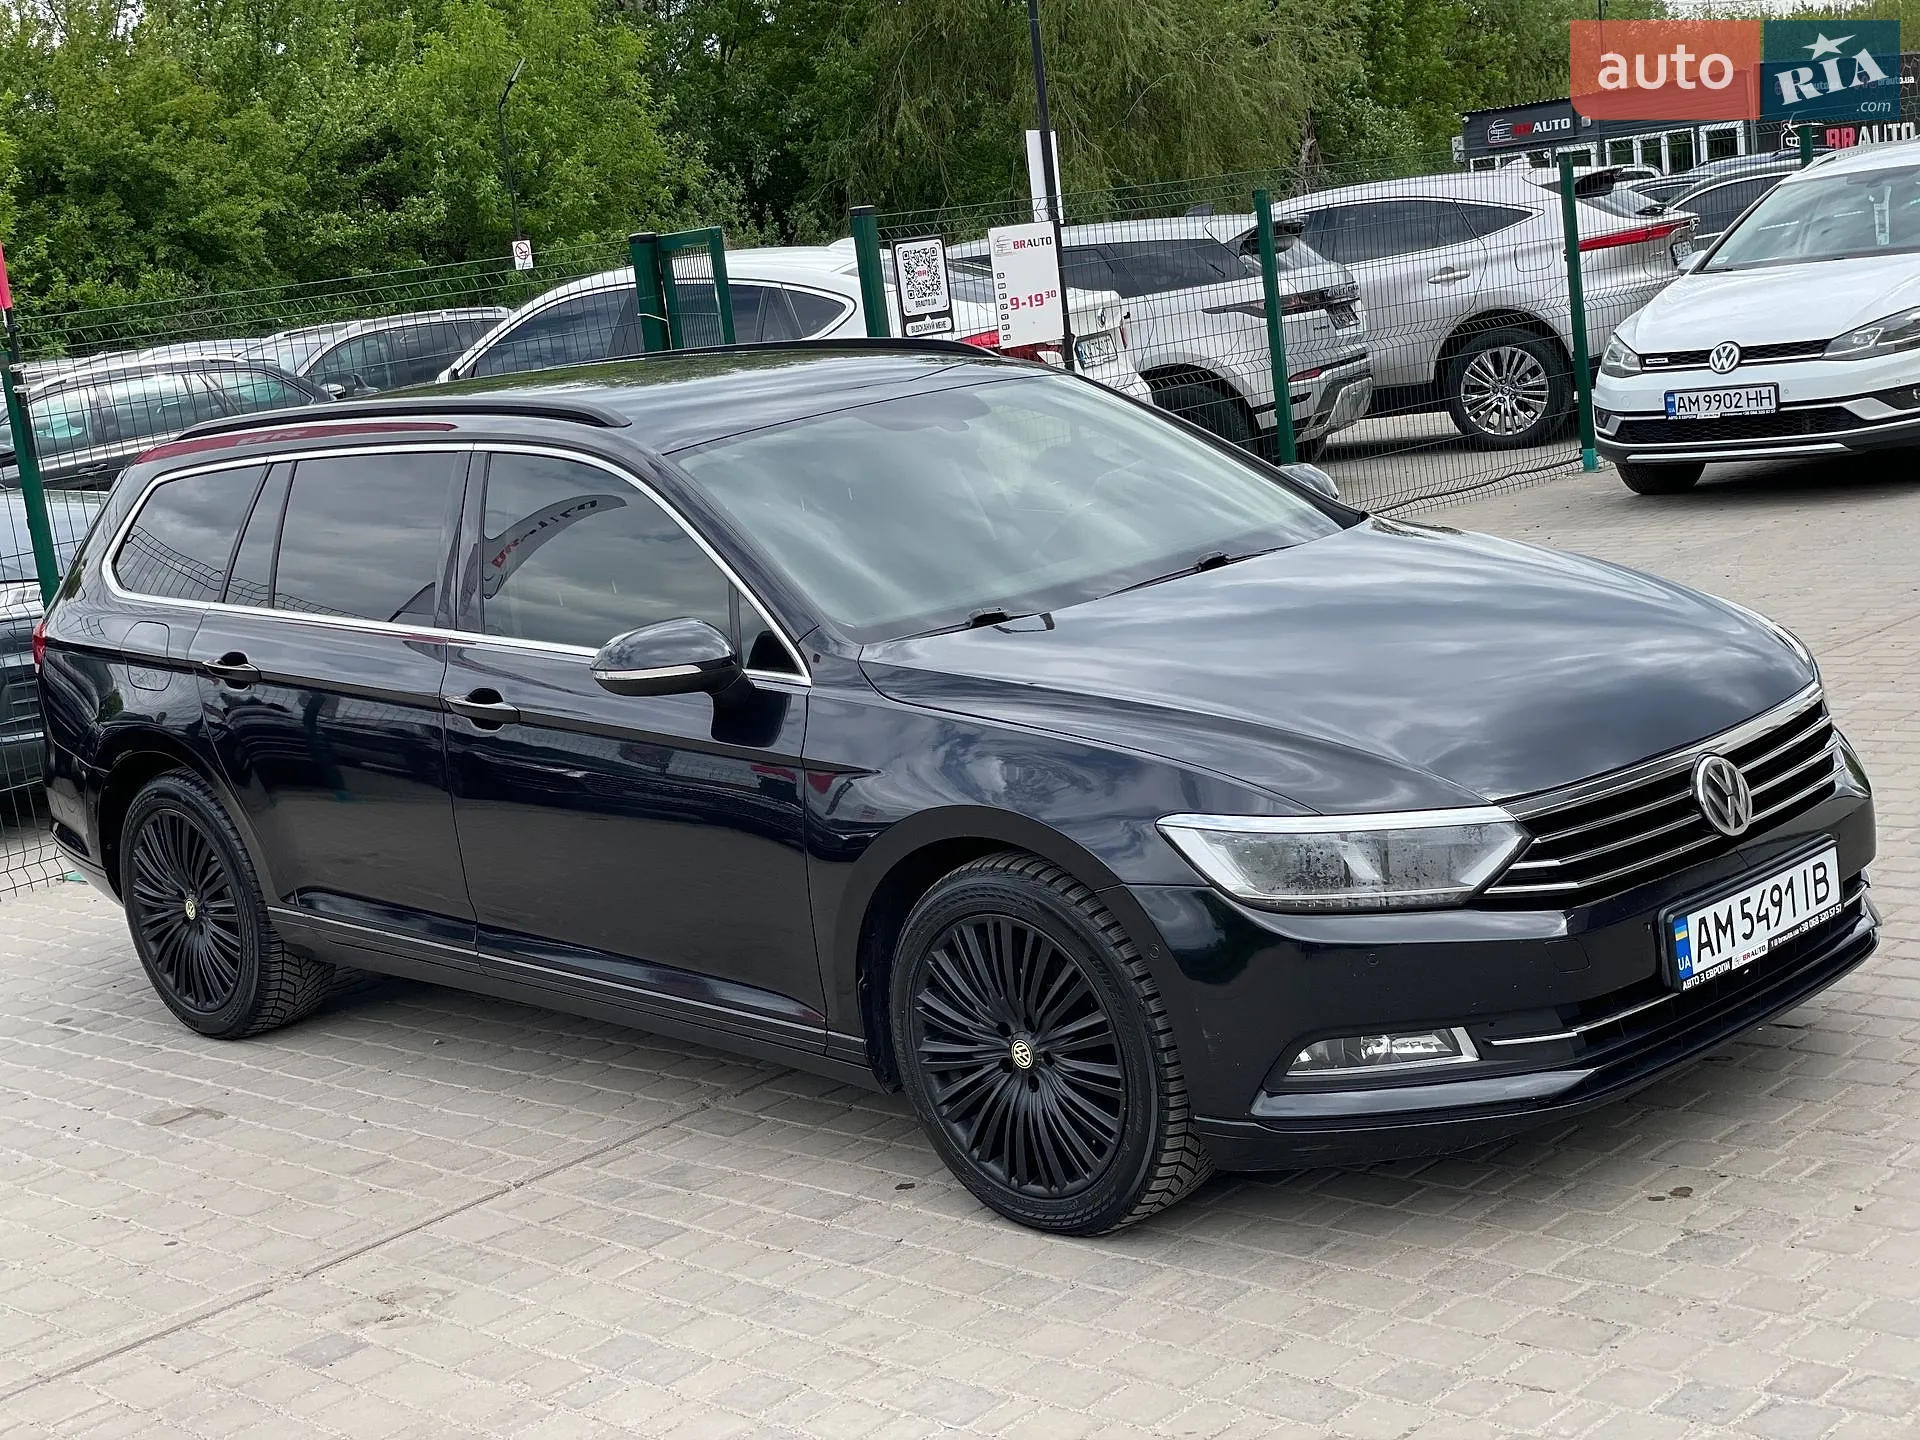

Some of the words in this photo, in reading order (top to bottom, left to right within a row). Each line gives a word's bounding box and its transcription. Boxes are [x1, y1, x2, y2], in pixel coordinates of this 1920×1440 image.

[1013, 236, 1052, 249] BRAUTO
[1677, 395, 1701, 413] AM
[1703, 392, 1744, 411] 9902
[1746, 389, 1773, 408] HH
[1697, 904, 1736, 963] AM
[1739, 876, 1797, 941] 5491
[1803, 861, 1830, 911] IB
[1743, 944, 1767, 960] BRAUTO
[1677, 955, 1692, 971] UA
